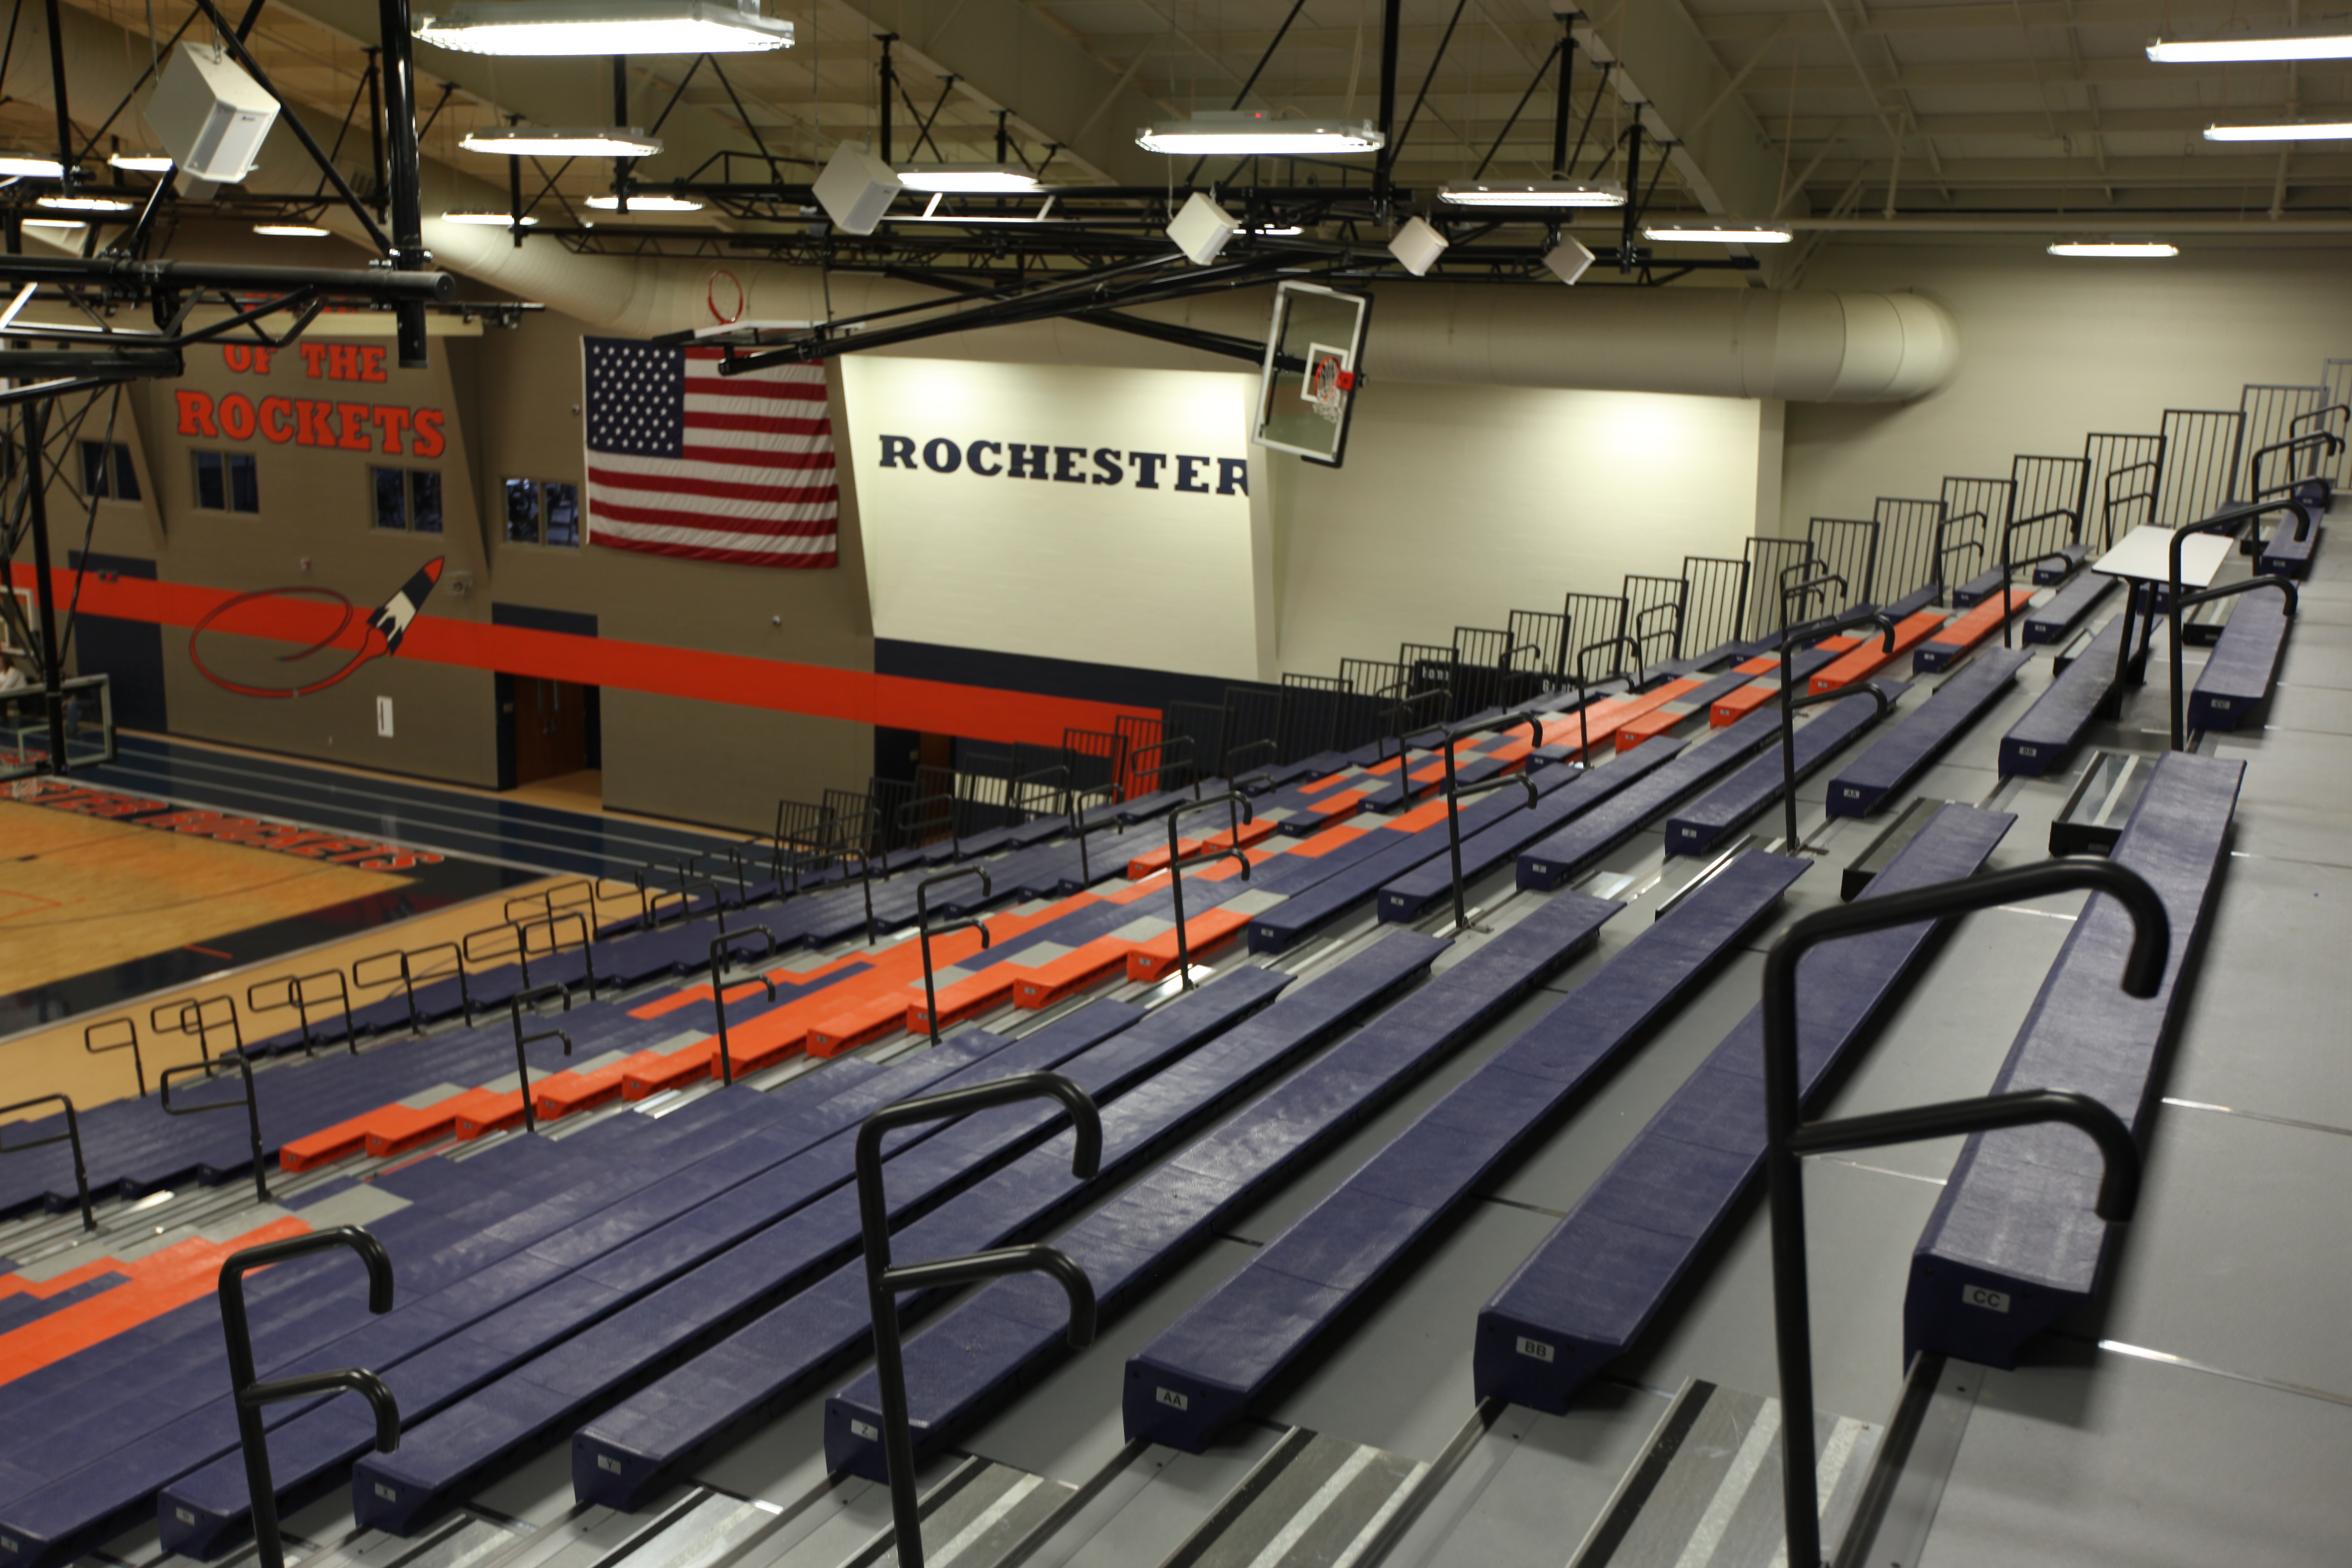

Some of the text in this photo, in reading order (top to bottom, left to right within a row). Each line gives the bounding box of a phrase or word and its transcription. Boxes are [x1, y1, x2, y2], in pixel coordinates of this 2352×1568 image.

[224, 342, 388, 383] OF THE
[175, 389, 446, 459] ROCKETS
[879, 434, 1249, 497] ROCHESTER
[134, 809, 444, 871] ROCKETS
[1973, 1289, 2000, 1308] CC
[1525, 1340, 1547, 1358] BB
[1163, 1390, 1181, 1407] AA
[182, 1509, 189, 1521] W
